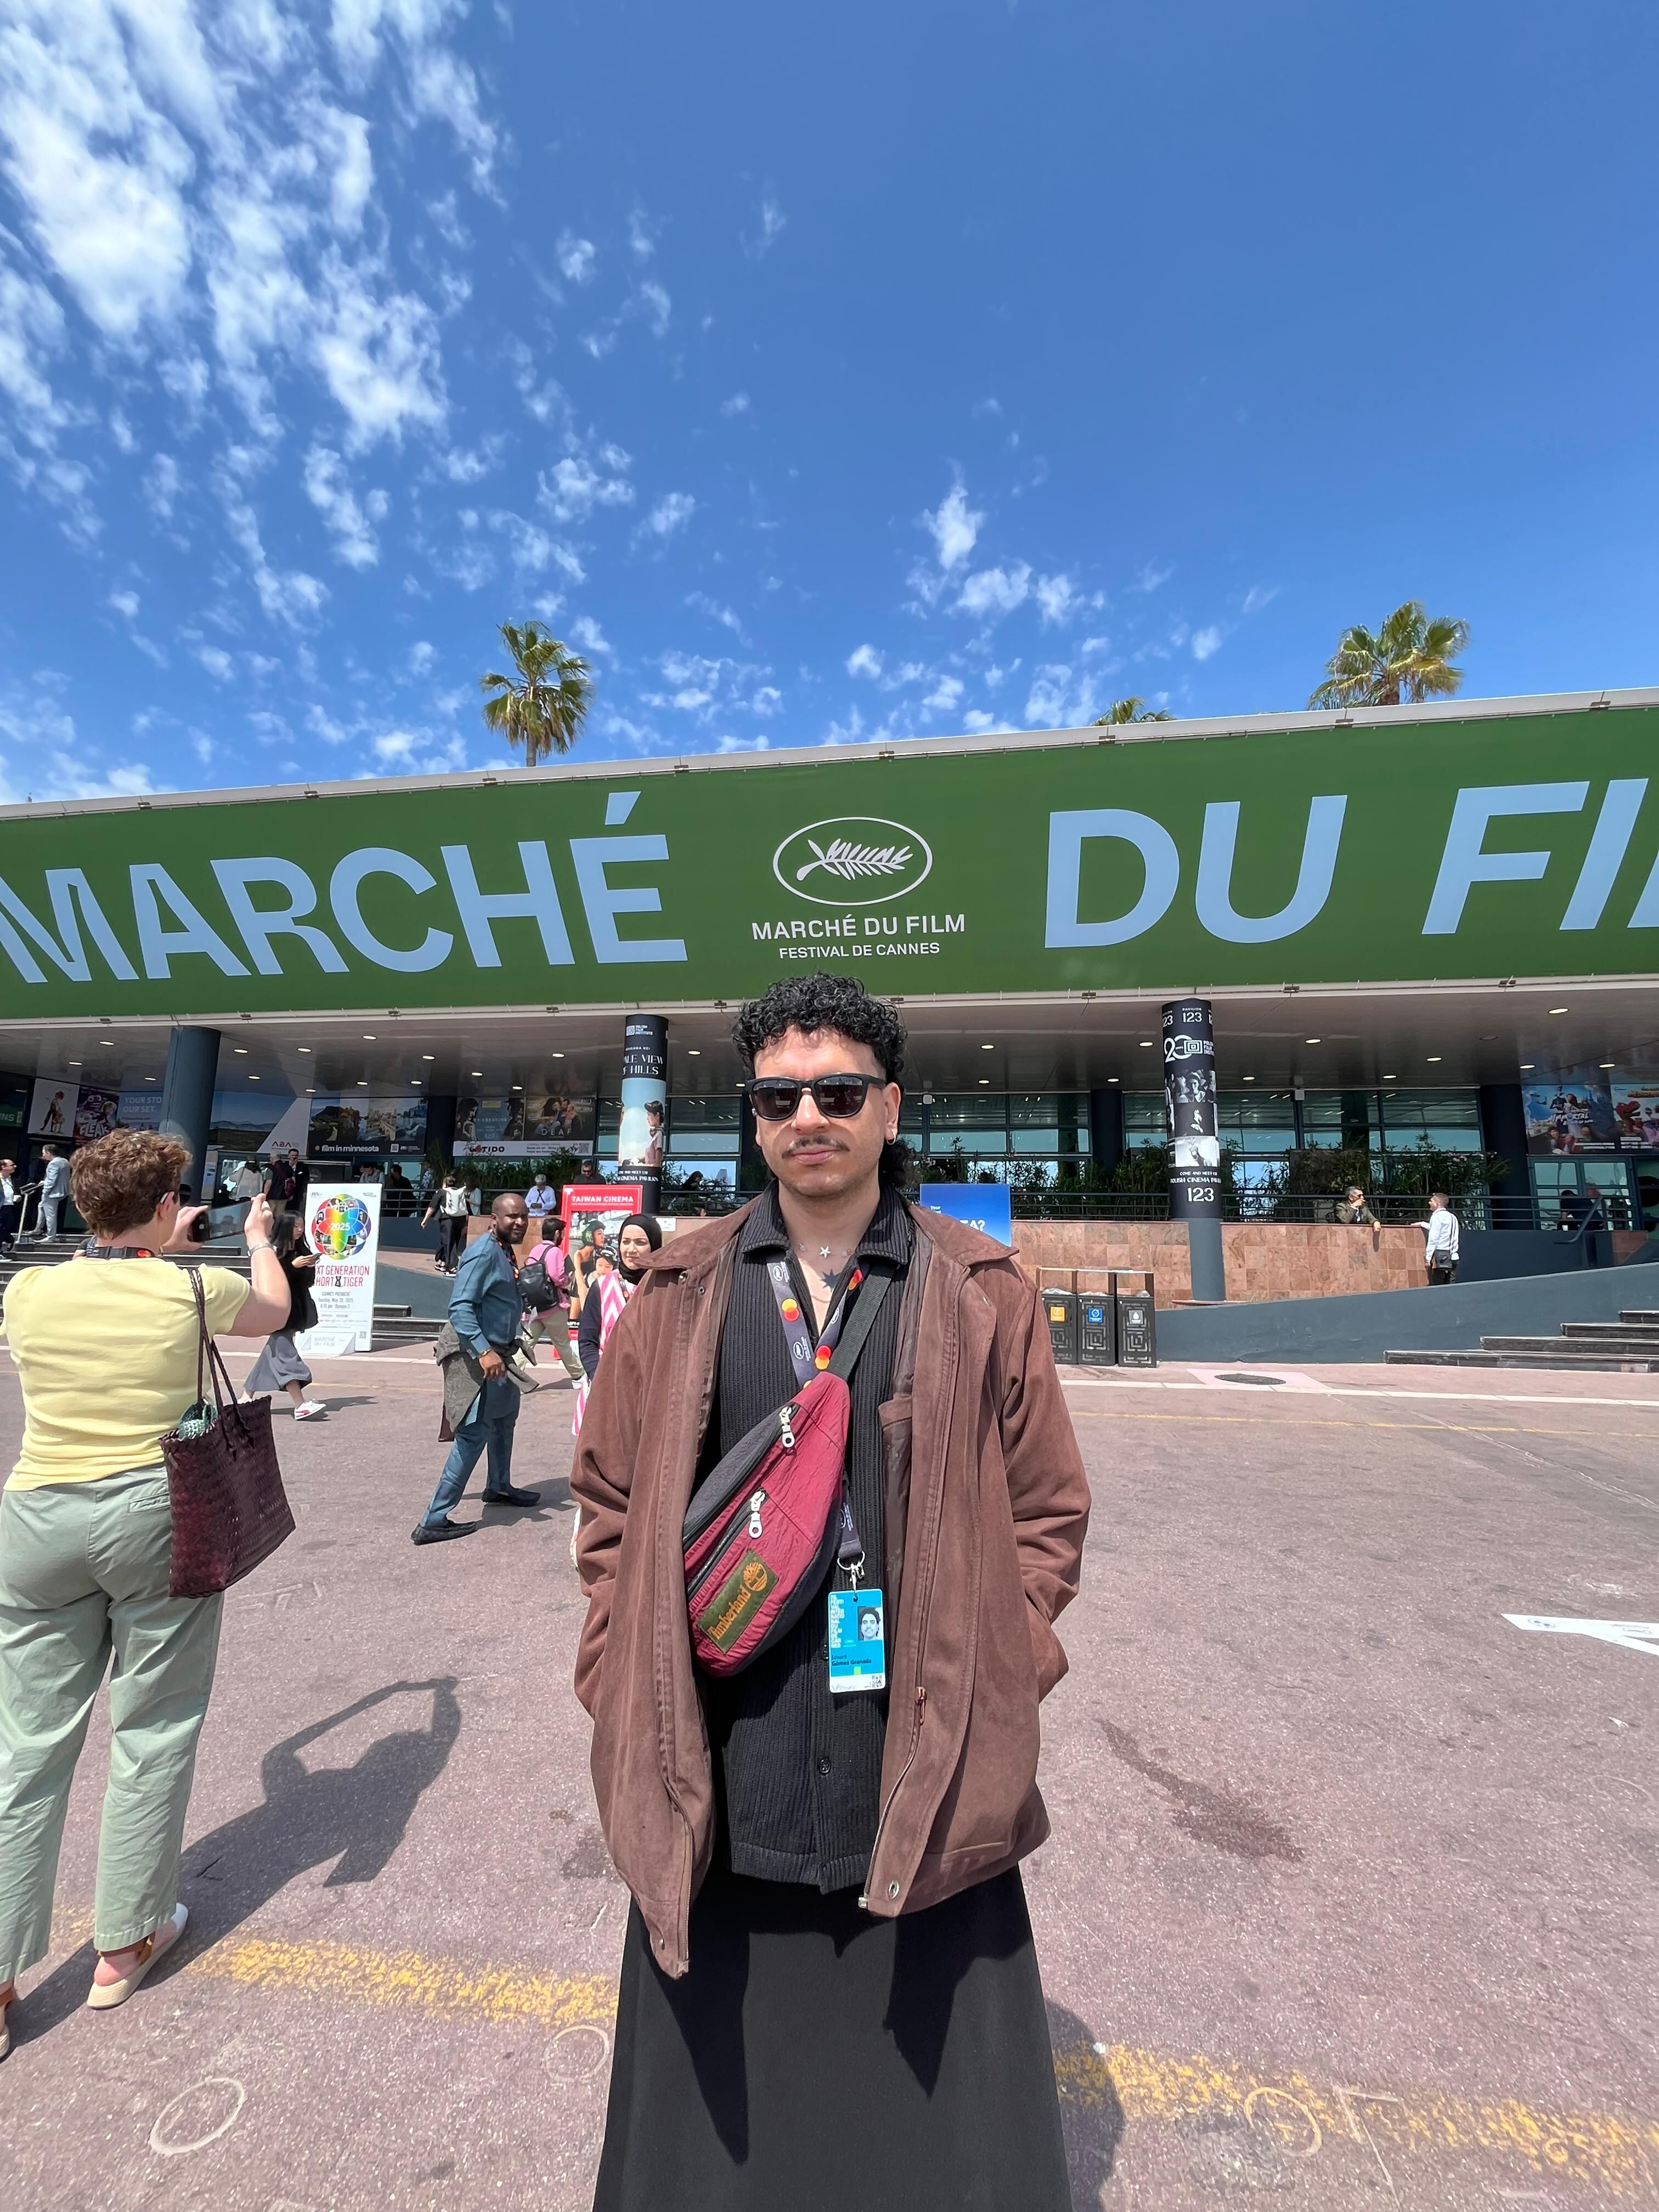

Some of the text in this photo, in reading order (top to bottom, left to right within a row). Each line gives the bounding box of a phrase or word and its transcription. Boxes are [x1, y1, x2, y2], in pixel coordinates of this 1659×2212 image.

[0, 791, 688, 983] MARCHÉ
[1045, 795, 1348, 948] DU
[752, 914, 965, 940] MARCHÉ DU FILM
[779, 943, 940, 959] FESTIVAL DE CANNES
[1163, 1015, 1173, 1028] 23
[1183, 1012, 1202, 1023] 123
[623, 1054, 663, 1064] ALE VIEW
[630, 1065, 659, 1075] HILLS
[1187, 1187, 1215, 1201] 123
[330, 1222, 351, 1231] 2025
[325, 1265, 370, 1276] GENERATION
[316, 1277, 364, 1287] HORT TIGER
[707, 1584, 751, 1640] Timberland
